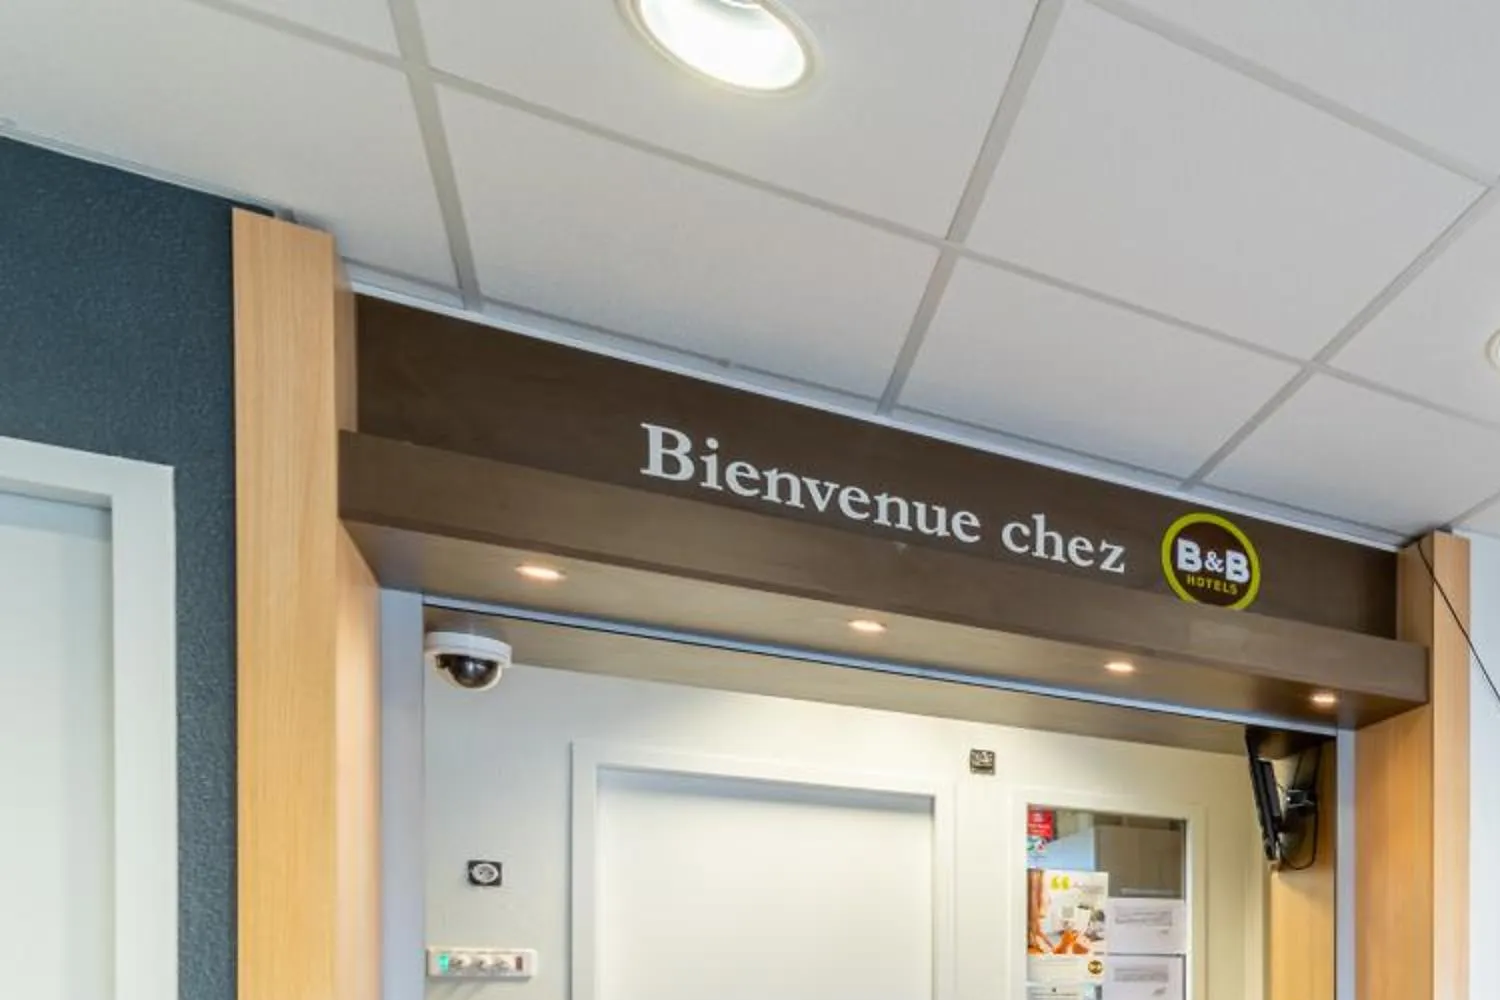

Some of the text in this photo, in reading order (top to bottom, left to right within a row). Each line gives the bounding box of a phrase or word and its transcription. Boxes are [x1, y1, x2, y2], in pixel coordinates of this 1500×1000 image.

[640, 422, 1126, 575] Bienvenue chez
[1177, 538, 1249, 584] B&B
[1186, 574, 1238, 595] HOTELS
